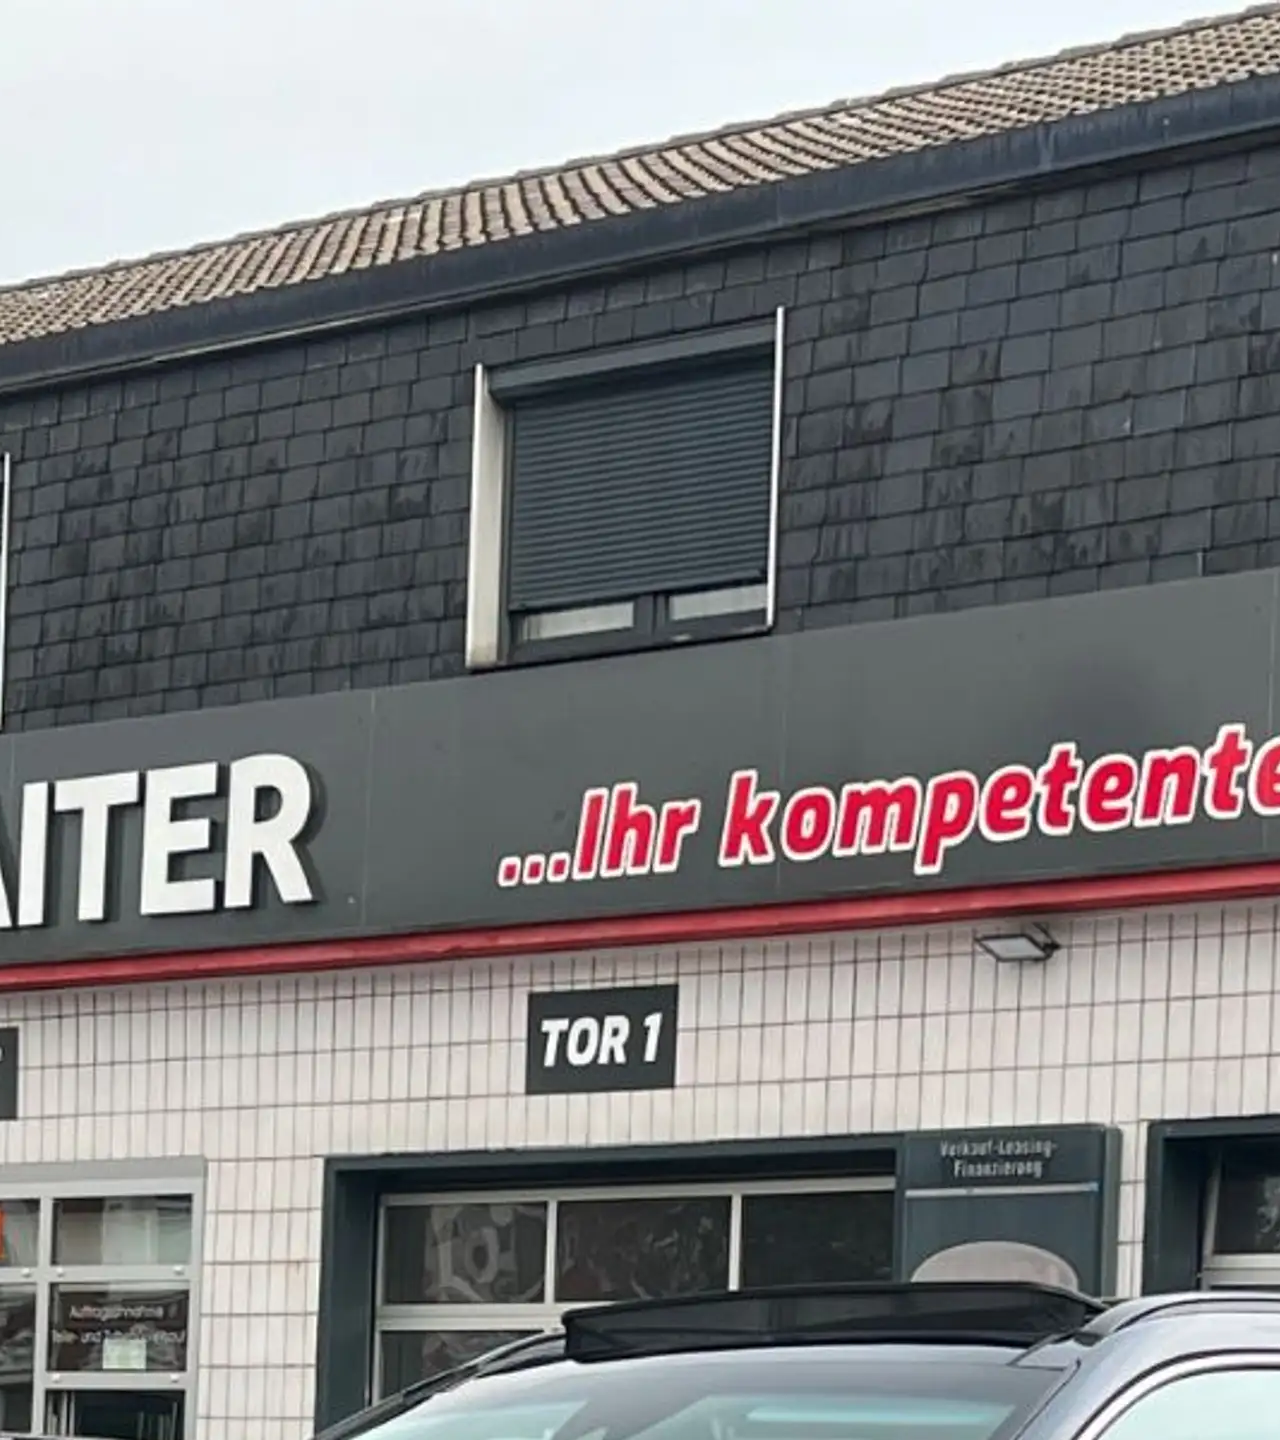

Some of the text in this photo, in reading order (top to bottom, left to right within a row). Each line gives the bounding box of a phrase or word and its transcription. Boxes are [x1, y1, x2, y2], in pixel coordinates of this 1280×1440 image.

[497, 782, 701, 888] ...Ihr
[539, 1012, 663, 1068] TOR 1
[953, 1160, 1043, 1178] Finanzierung
